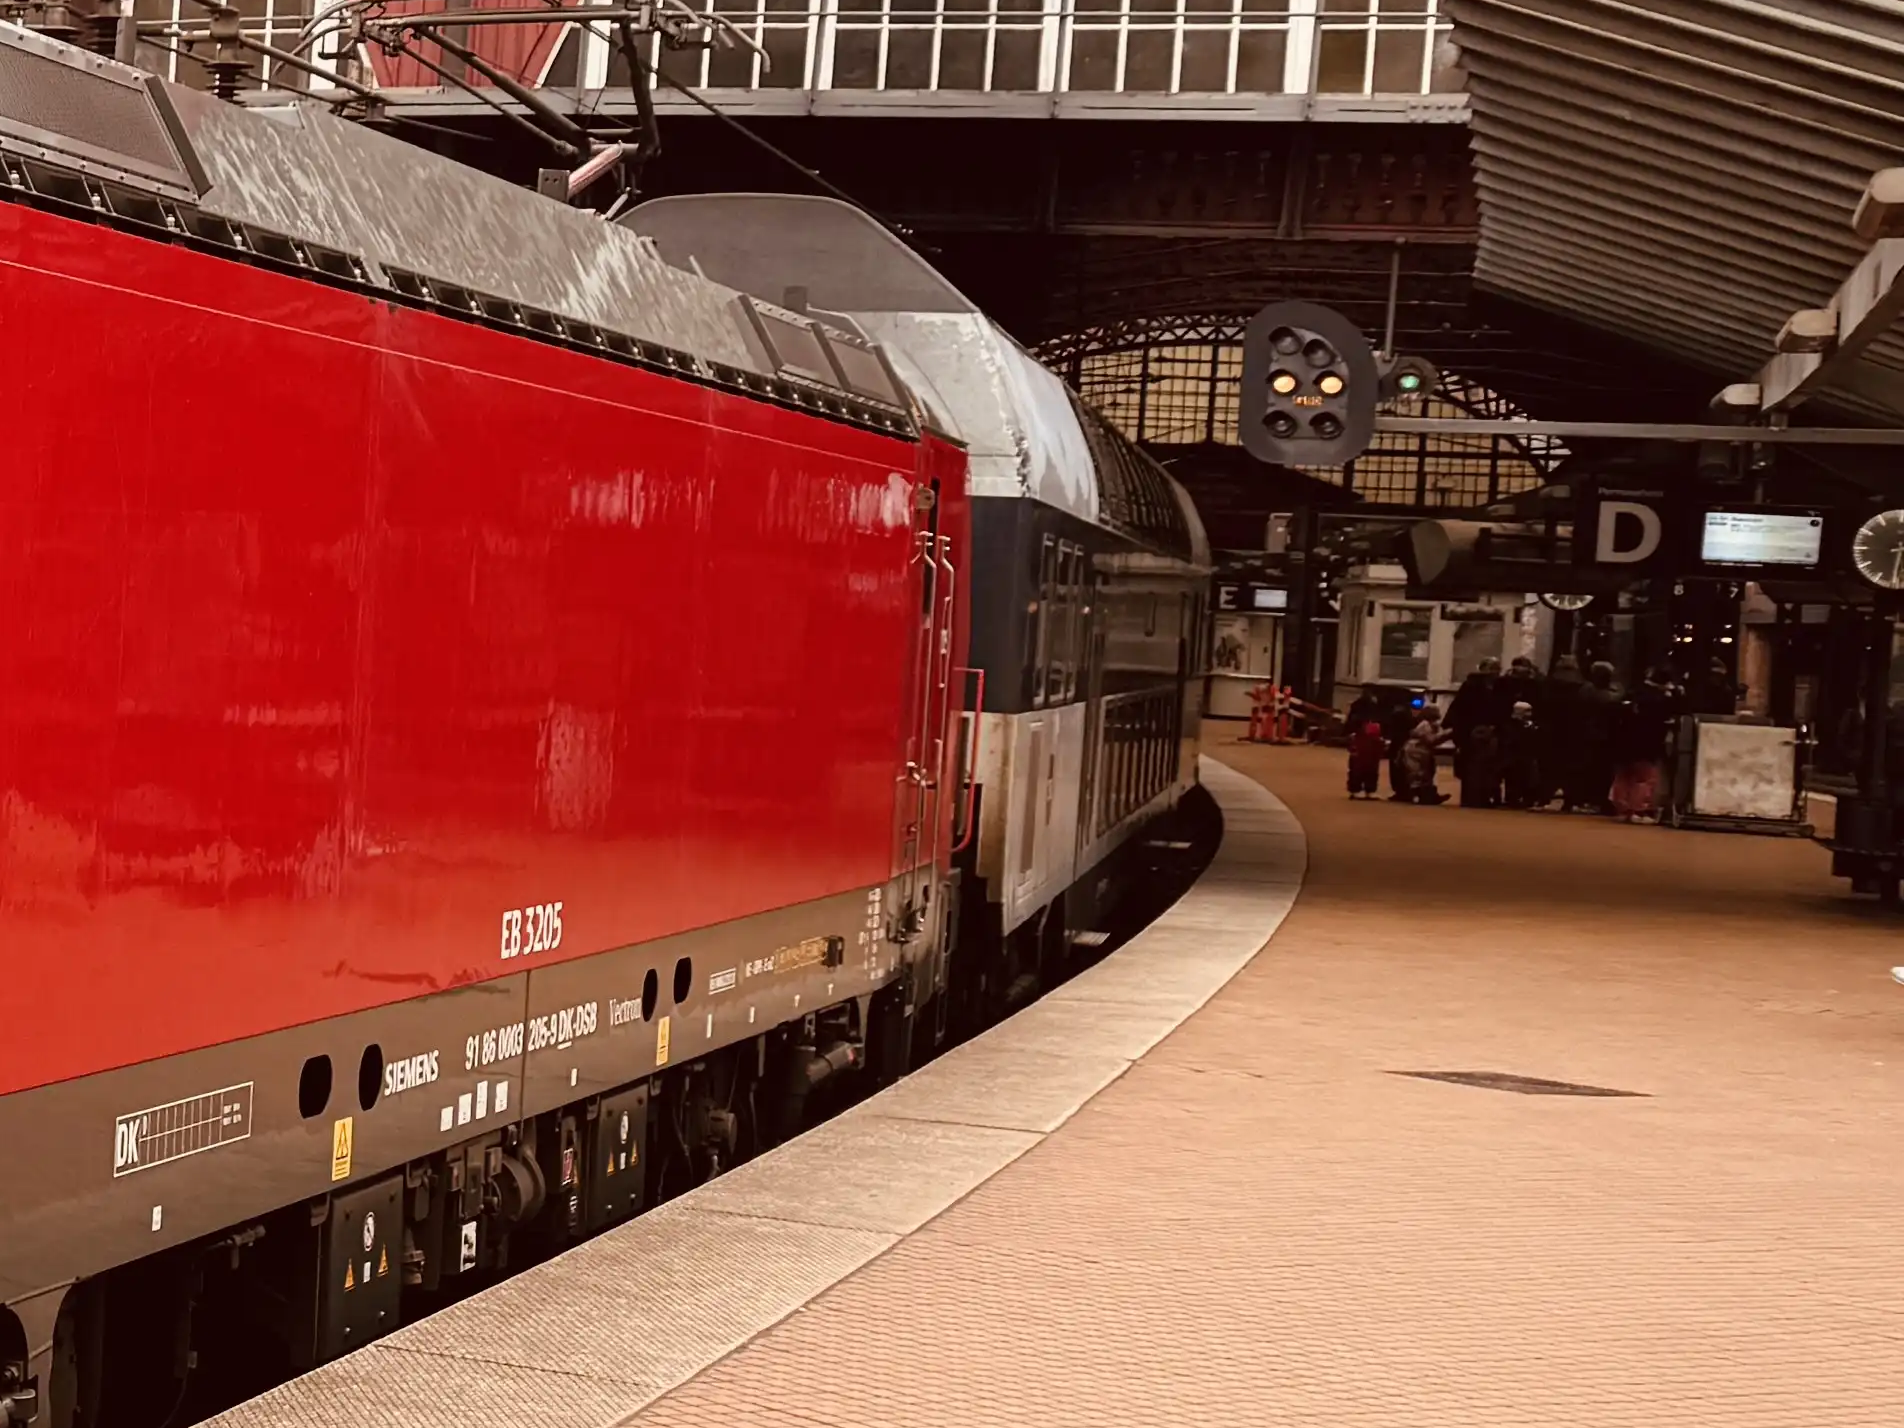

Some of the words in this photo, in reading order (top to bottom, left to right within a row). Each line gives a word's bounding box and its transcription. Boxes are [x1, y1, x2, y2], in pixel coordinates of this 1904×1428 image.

[1595, 500, 1662, 563] D
[1219, 586, 1239, 610] E
[500, 909, 522, 960] EB
[523, 901, 563, 956] 3205
[384, 1049, 440, 1096] SIEMENS
[465, 1033, 479, 1070] 91
[481, 1029, 497, 1064] 86
[498, 1023, 524, 1061] 0003
